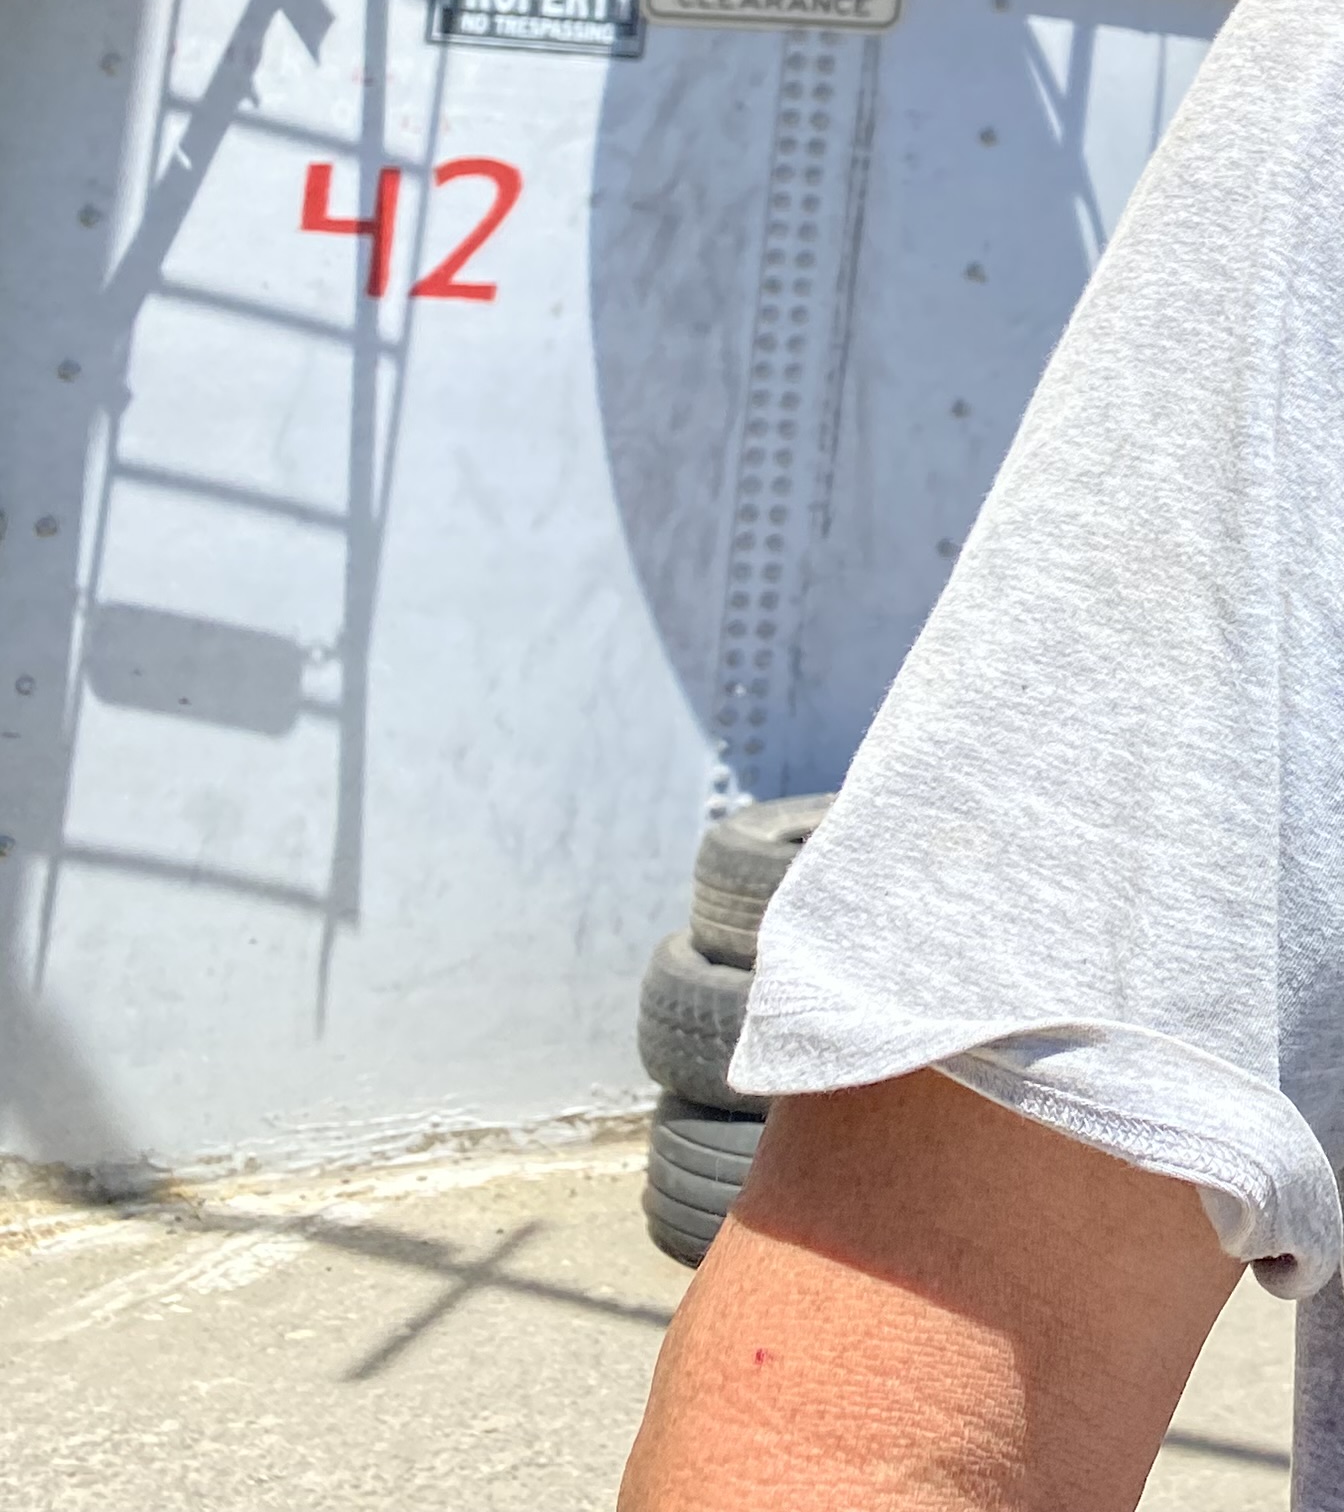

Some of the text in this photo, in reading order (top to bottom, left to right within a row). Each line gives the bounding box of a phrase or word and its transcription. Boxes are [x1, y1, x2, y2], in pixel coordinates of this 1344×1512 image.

[460, 12, 616, 44] NO TRESPASSING
[301, 156, 523, 301] 42
